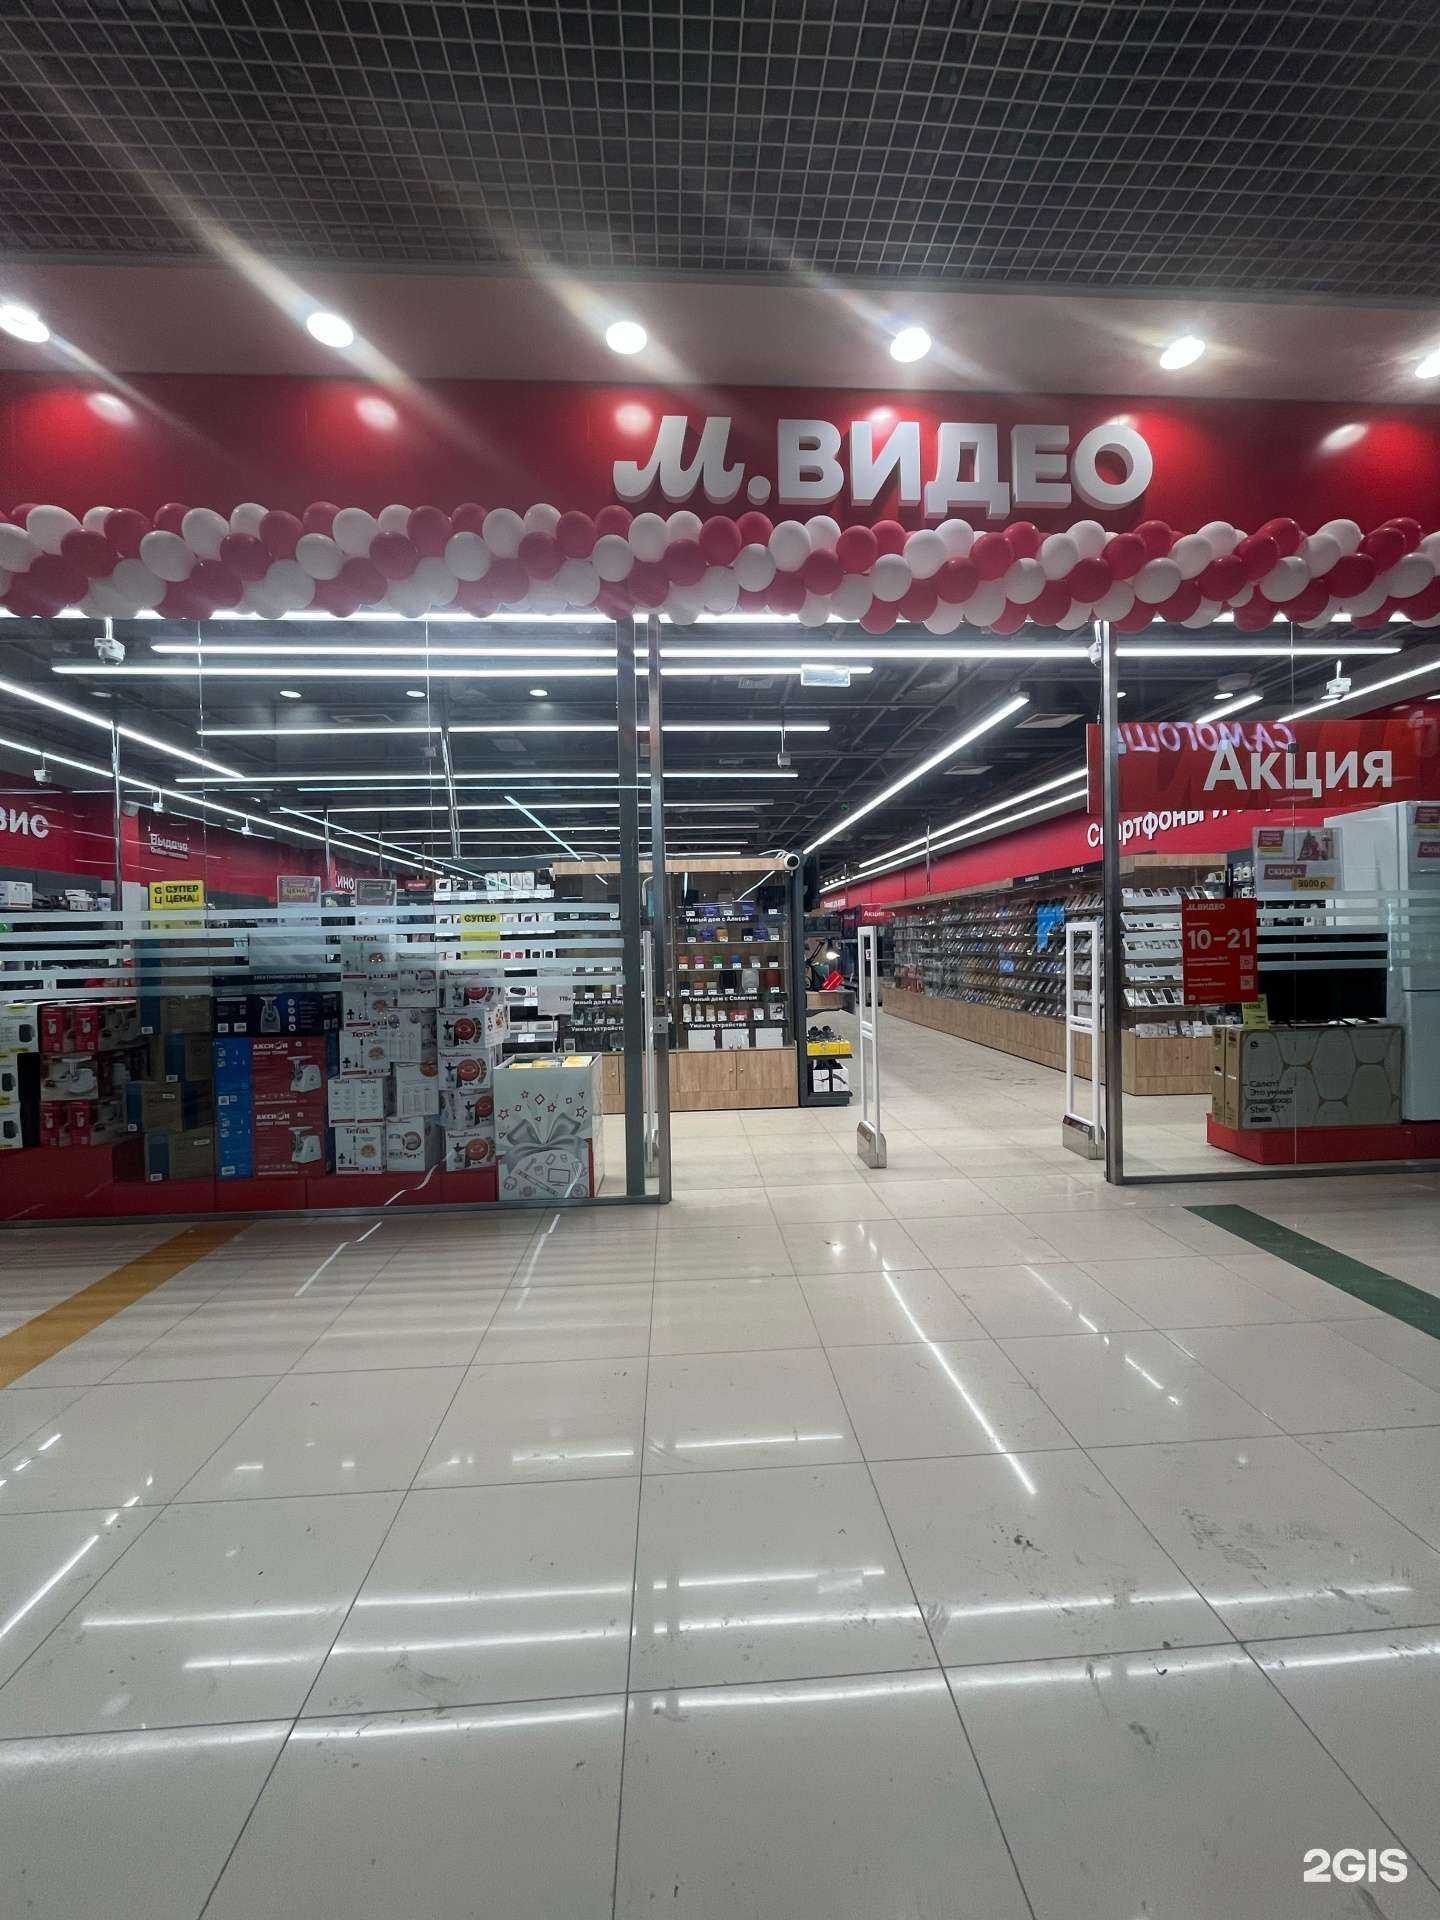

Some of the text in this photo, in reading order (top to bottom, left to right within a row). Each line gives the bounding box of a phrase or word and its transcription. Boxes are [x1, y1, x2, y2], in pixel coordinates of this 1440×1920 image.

[1202, 739, 1393, 798] Акция
[165, 884, 199, 893] СУПЕР
[463, 914, 497, 923] СУПЕР
